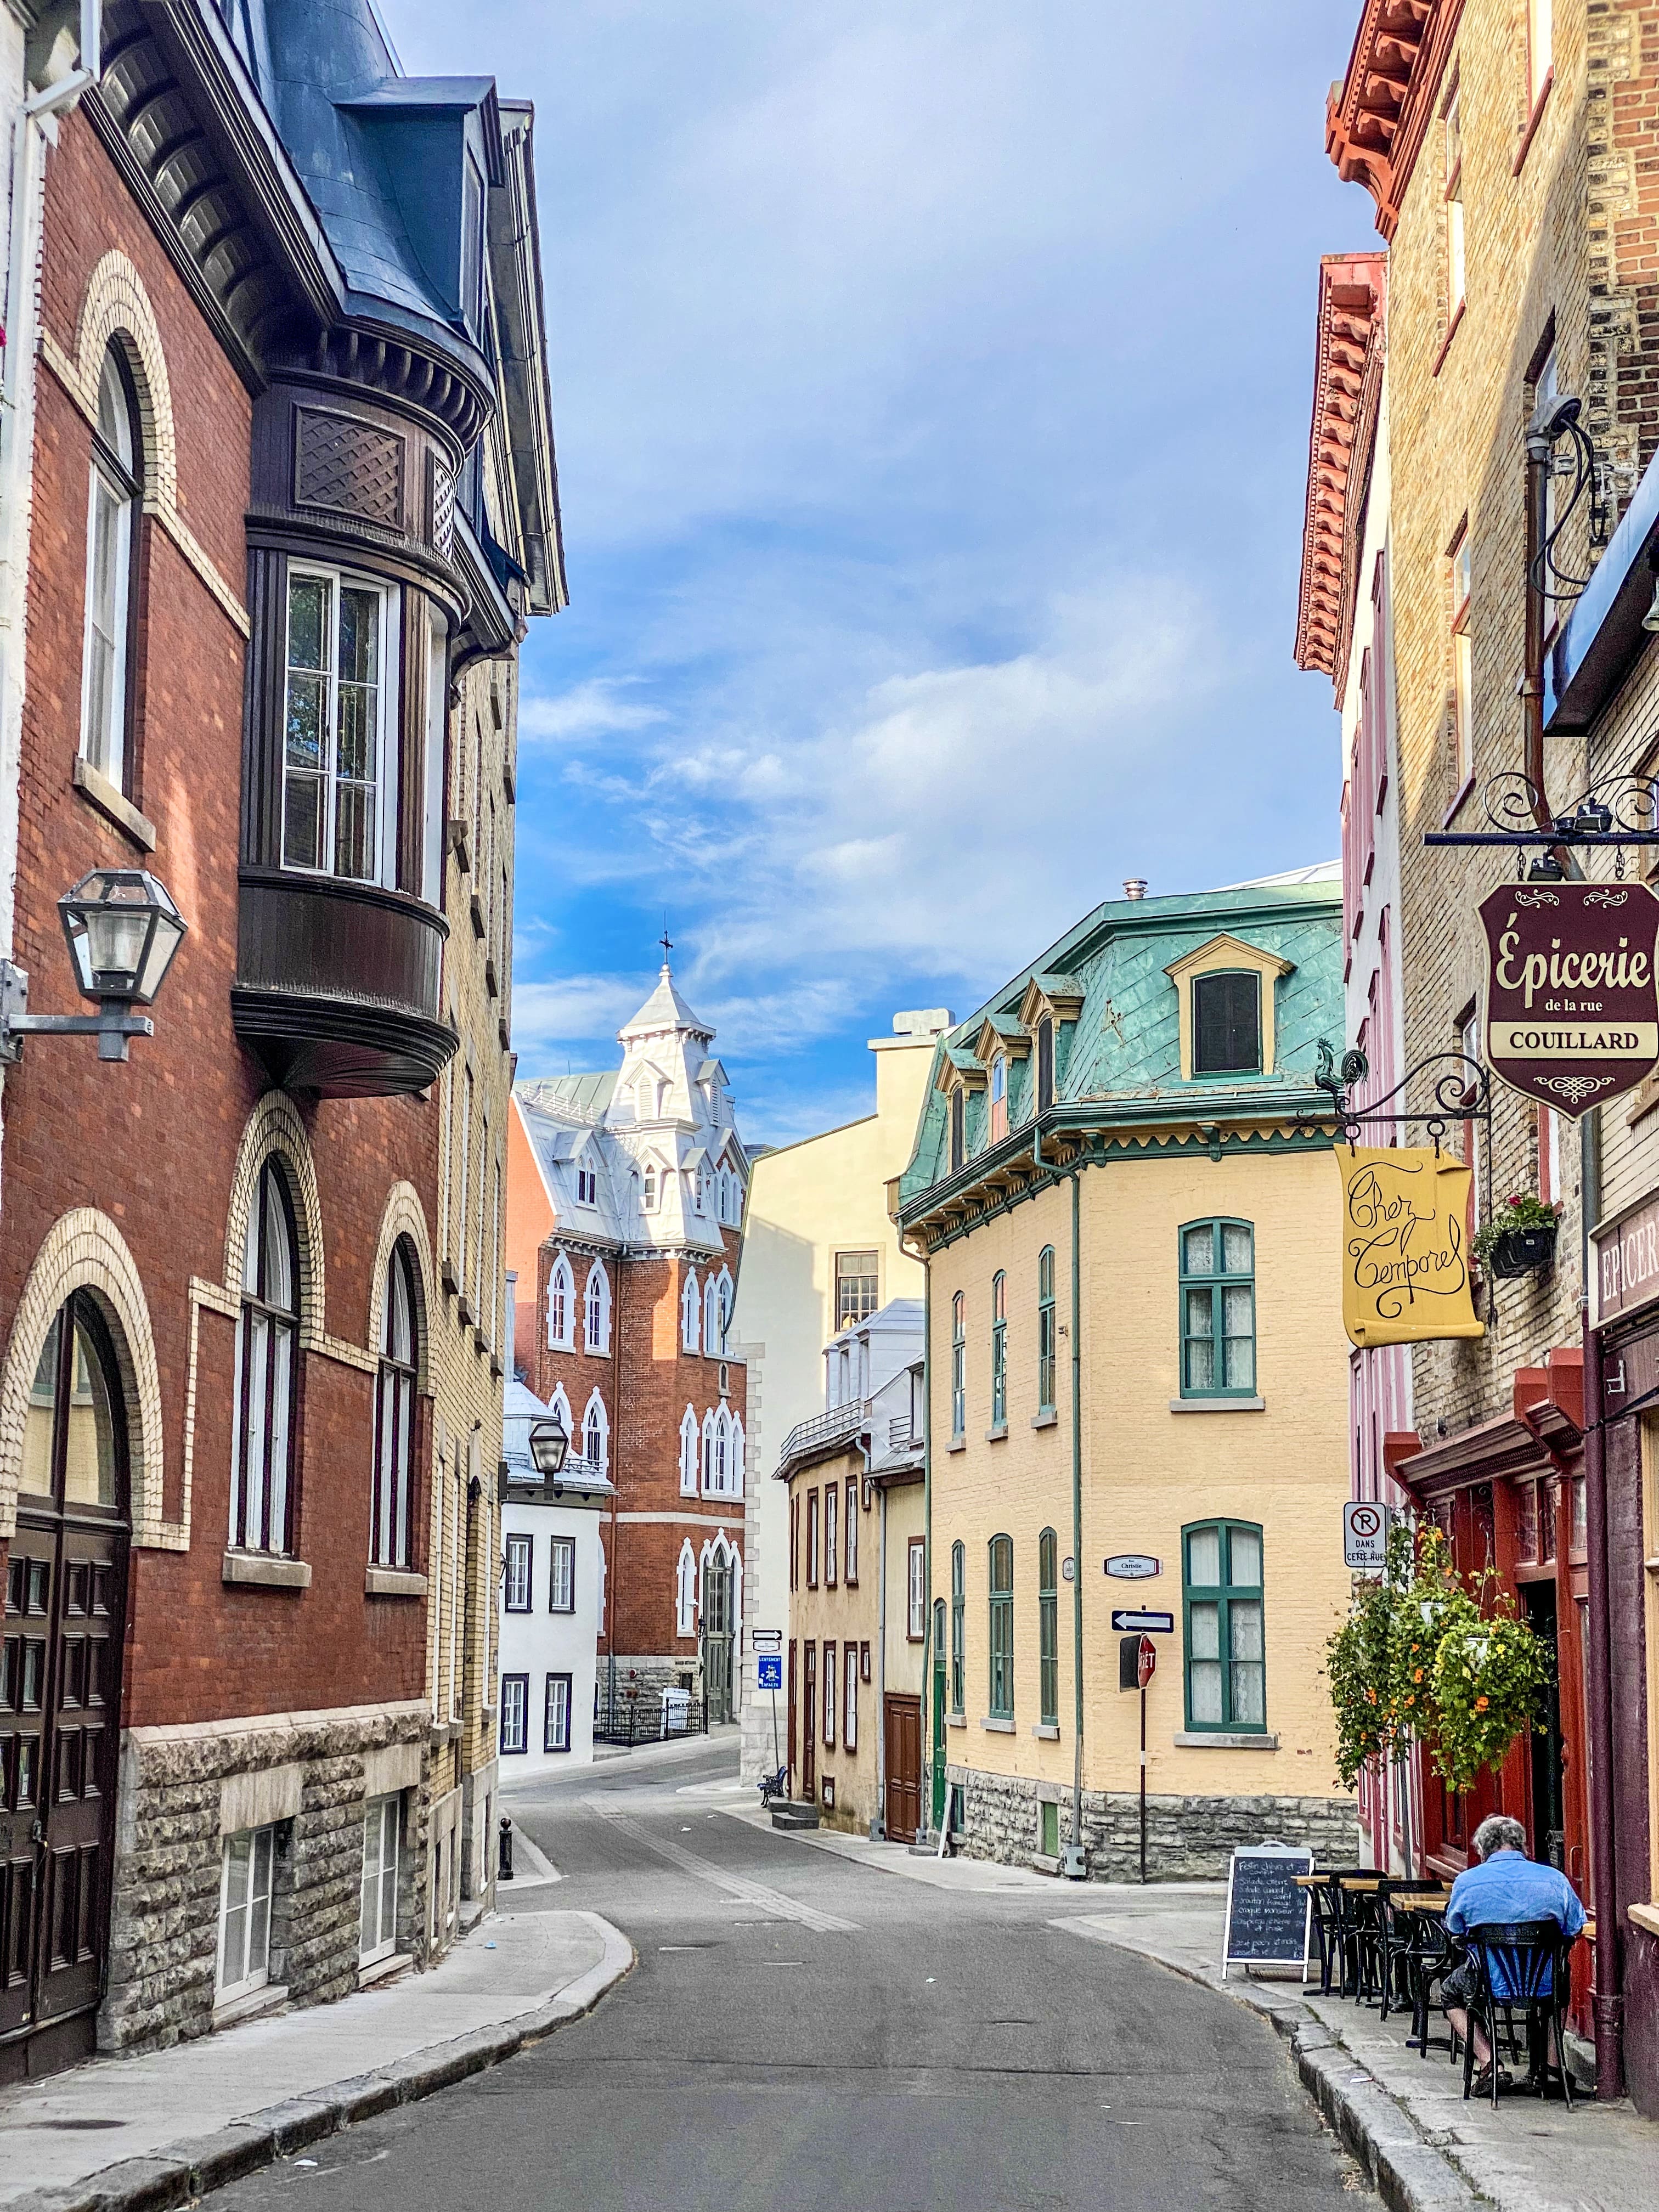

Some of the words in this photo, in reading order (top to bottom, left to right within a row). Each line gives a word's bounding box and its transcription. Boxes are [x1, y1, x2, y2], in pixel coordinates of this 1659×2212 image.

[1496, 912, 1651, 1009] Épicerie
[1545, 998, 1561, 1011] de
[1564, 998, 1576, 1011] la
[1580, 1001, 1603, 1011] rue
[1510, 1031, 1639, 1049] COUILLARD
[1348, 1161, 1435, 1229] Chez
[1348, 1214, 1465, 1318] Temporel
[1347, 1553, 1367, 1561] CETTE
[1370, 1553, 1384, 1561] RUE
